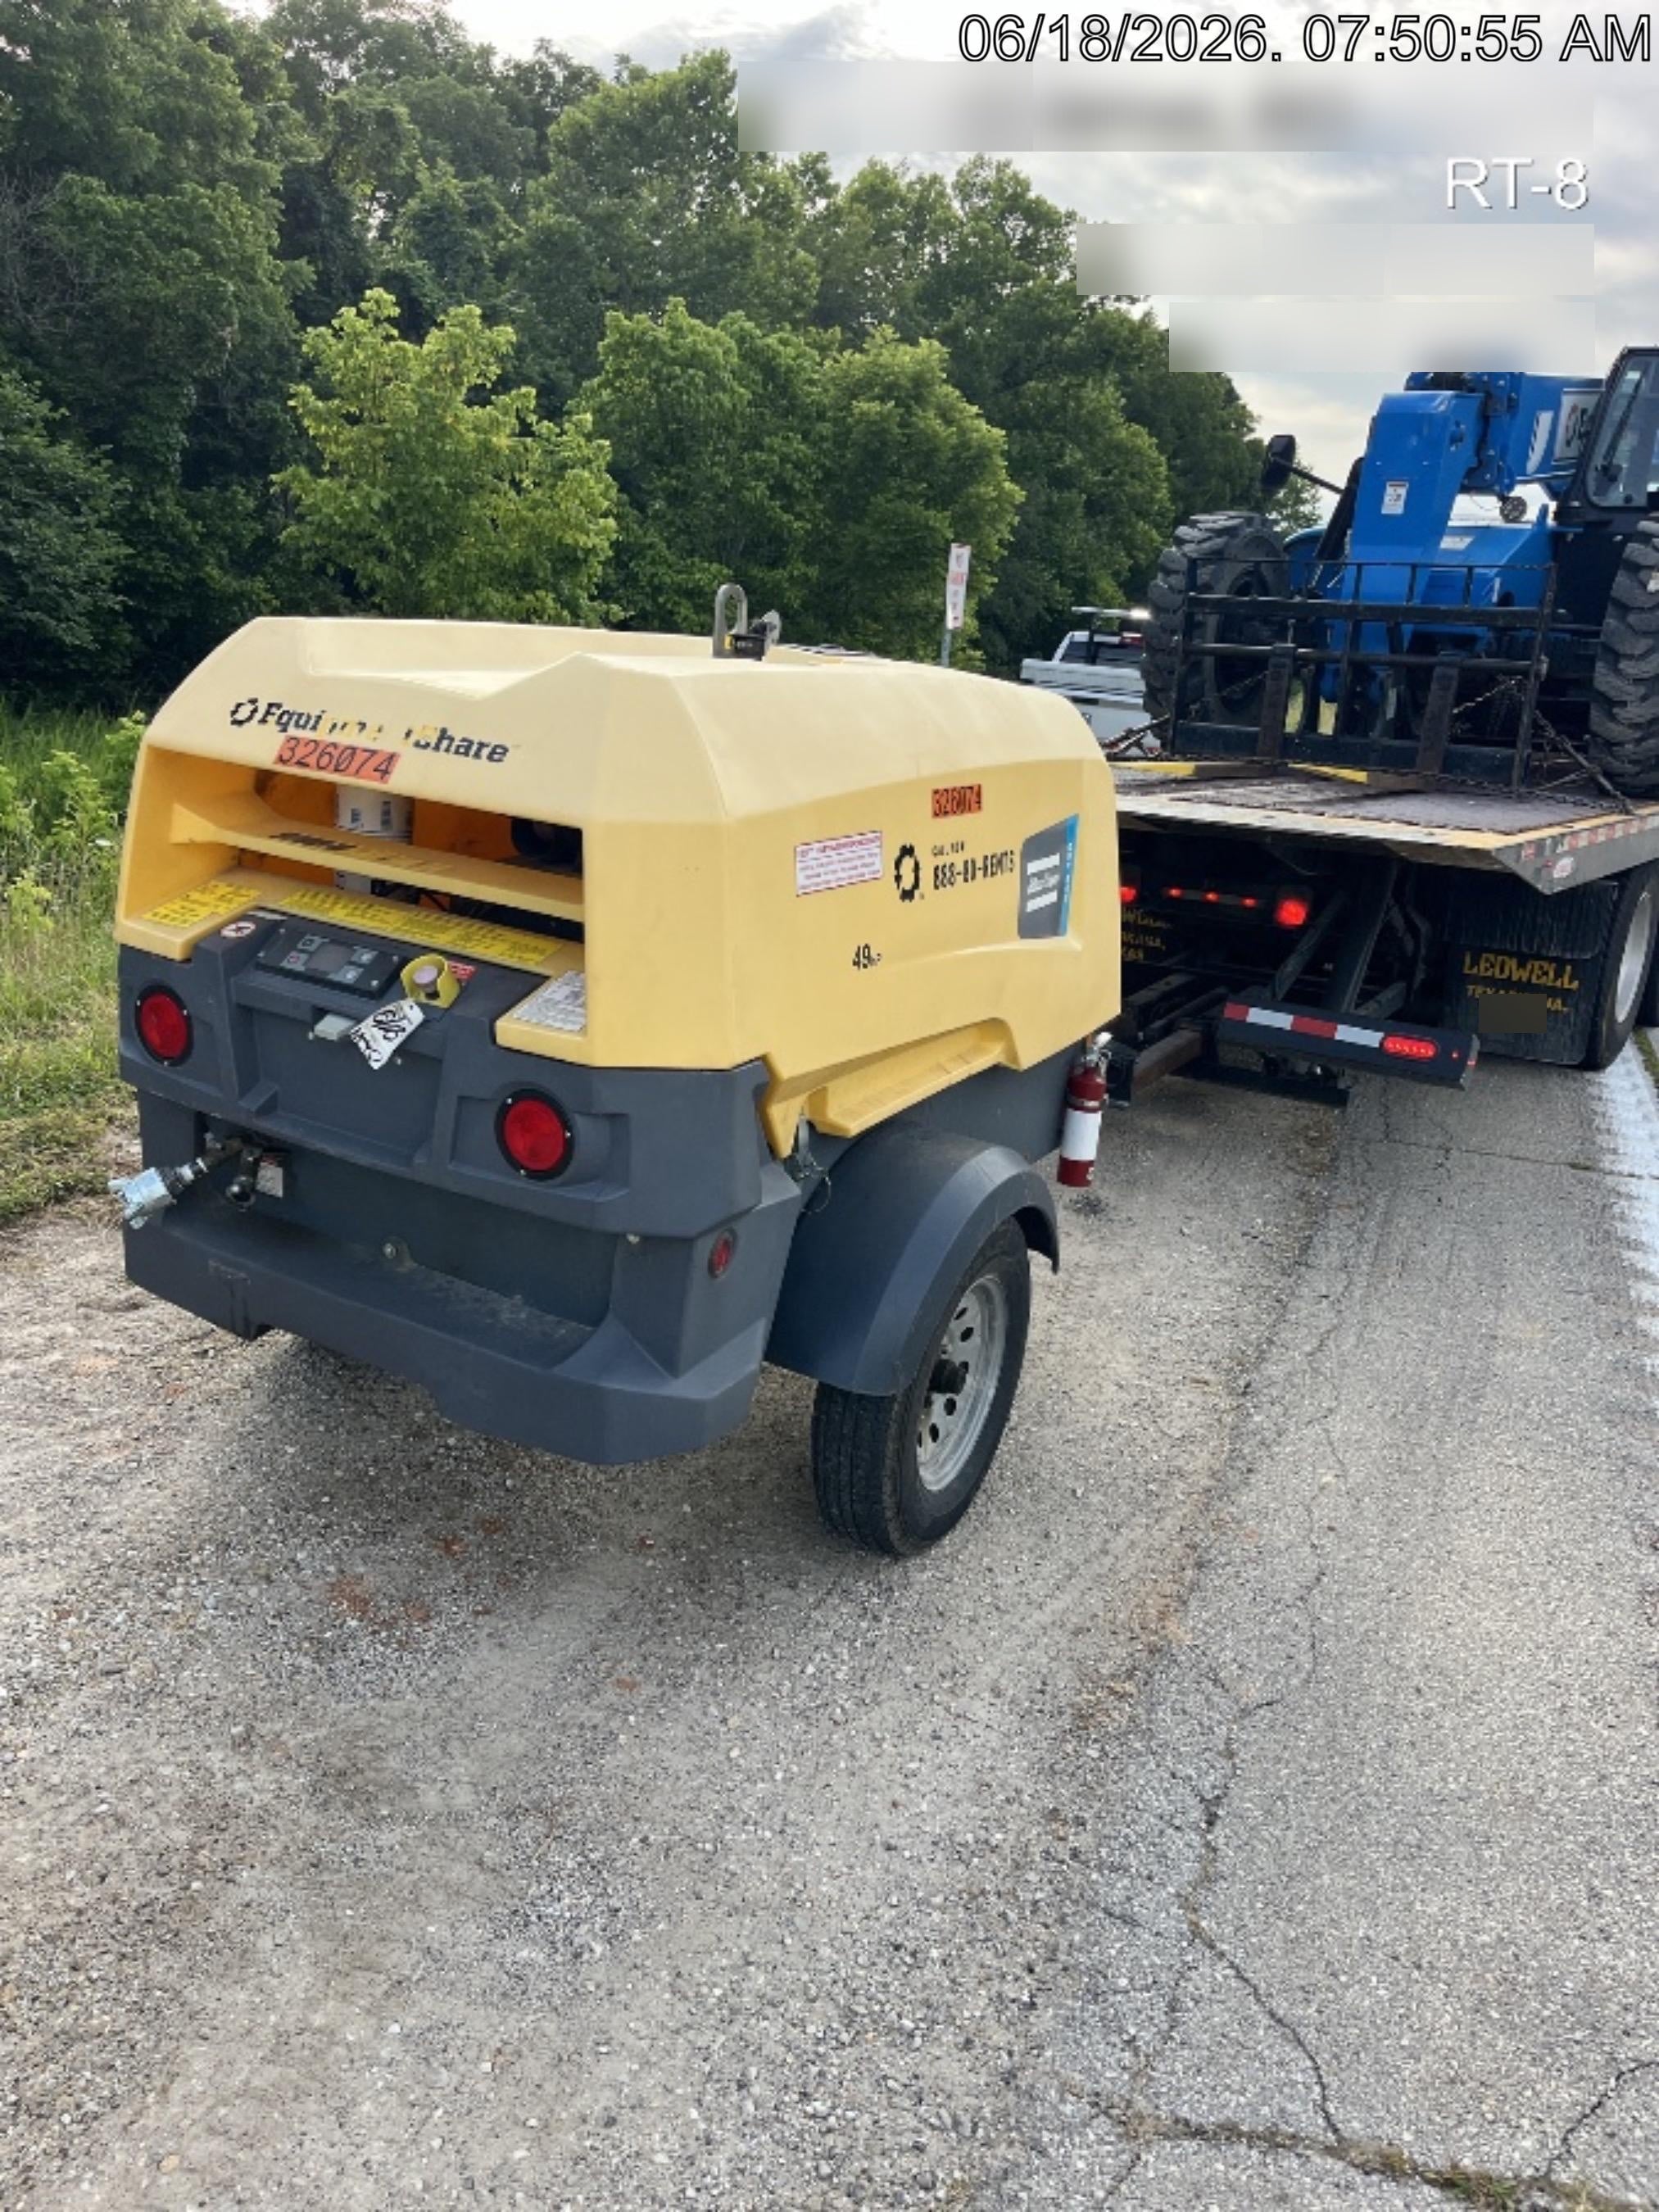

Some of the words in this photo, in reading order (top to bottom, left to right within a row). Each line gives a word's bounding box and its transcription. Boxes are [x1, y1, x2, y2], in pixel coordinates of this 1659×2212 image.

[279, 737, 397, 781] 326074
[933, 783, 981, 817] 326074
[1462, 950, 1580, 991] LEDWELL
